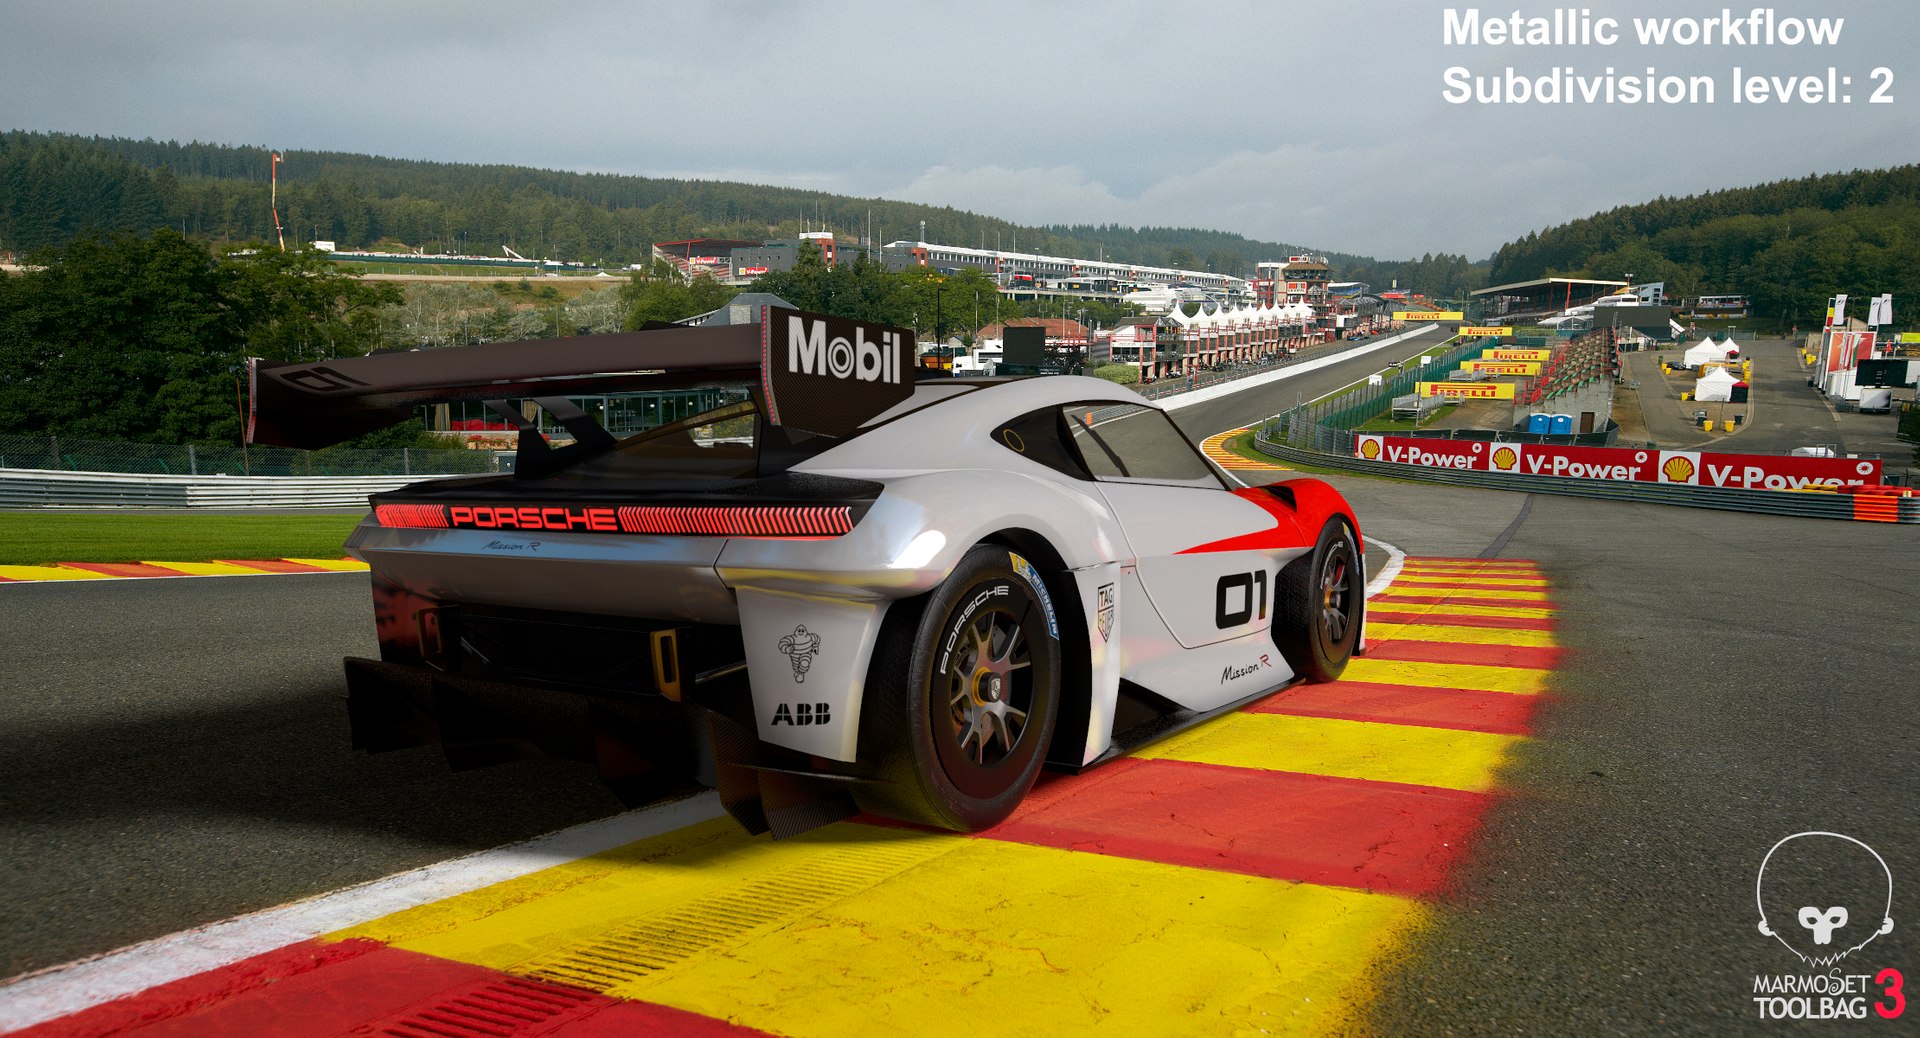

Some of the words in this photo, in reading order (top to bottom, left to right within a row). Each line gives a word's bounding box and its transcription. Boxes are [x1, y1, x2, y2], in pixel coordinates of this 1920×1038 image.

[1406, 312, 1440, 320] PIRELLI
[788, 315, 901, 385] Mobil
[1493, 351, 1539, 359] PIRELLI
[280, 366, 373, 392] 01
[1387, 445, 1478, 469] V-Power
[1526, 454, 1641, 481] V-Power
[450, 506, 618, 531] PORSCHE
[482, 540, 524, 551] Mission
[526, 541, 541, 552] R
[1099, 588, 1113, 607] TAG
[1215, 569, 1267, 630] 01
[940, 585, 1009, 675] PORSCHE
[1221, 665, 1259, 686] Mission
[1260, 654, 1272, 668] R
[771, 703, 831, 726] ABB
